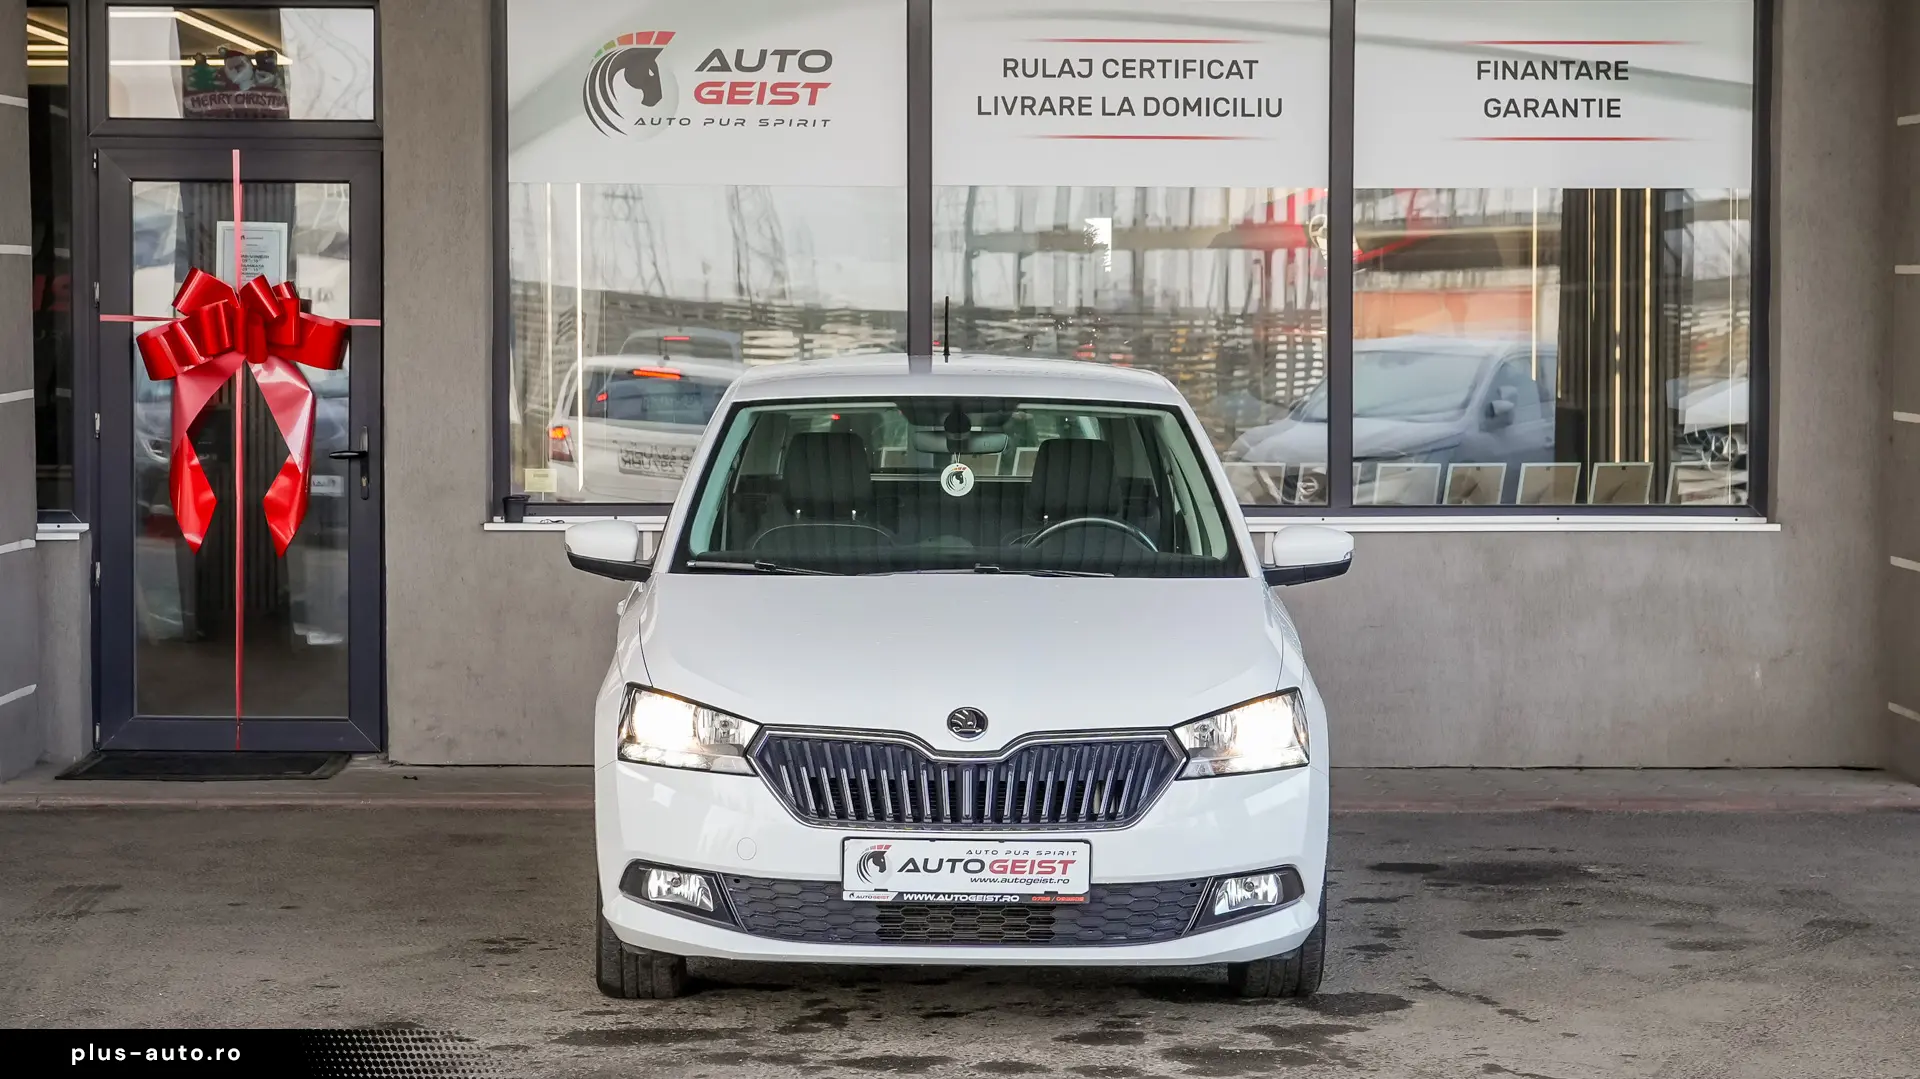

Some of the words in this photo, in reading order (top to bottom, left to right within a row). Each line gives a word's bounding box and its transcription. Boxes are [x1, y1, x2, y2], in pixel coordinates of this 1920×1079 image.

[694, 48, 833, 74] AUTO
[1002, 57, 1094, 80] RULAJ
[1101, 57, 1260, 80] CERTIFICAT
[1477, 59, 1631, 81] FINANTARE
[190, 94, 232, 109] MERRY
[234, 93, 288, 106] CHRISTMA
[693, 80, 832, 106] GEIST
[977, 95, 1093, 118] LIVRARE
[1101, 95, 1136, 118] LA
[1143, 95, 1283, 118] DOMICILIU
[1483, 97, 1623, 119] GARANTIE
[633, 116, 692, 128] AUTO
[703, 116, 746, 128] PUR
[758, 116, 832, 129] SPIRIT
[969, 876, 1071, 886] www.autogeist.ro
[903, 893, 1021, 902] WWW.AUTOGEIST.RO
